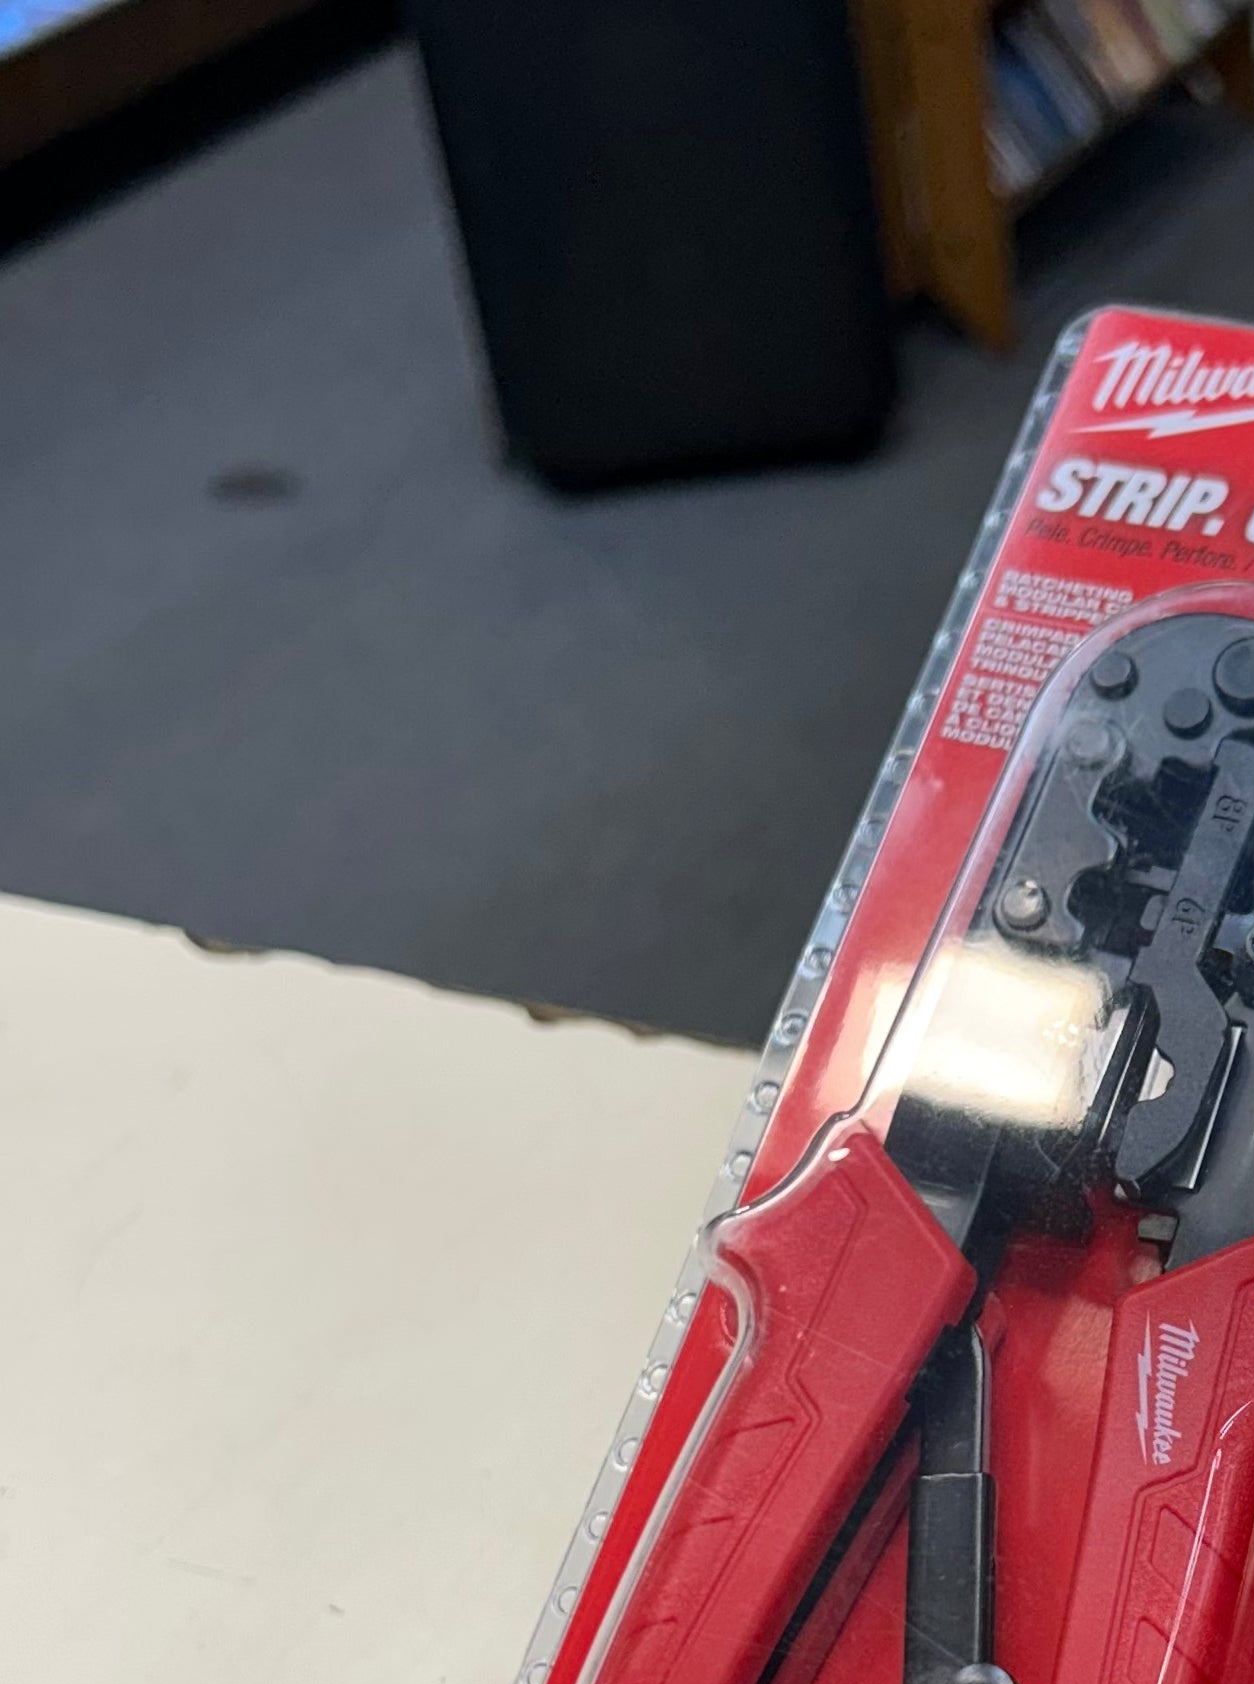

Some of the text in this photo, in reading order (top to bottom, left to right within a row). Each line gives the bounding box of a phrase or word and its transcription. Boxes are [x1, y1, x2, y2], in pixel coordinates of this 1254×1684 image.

[1035, 457, 1230, 538] STRIP.
[1077, 528, 1154, 559] Crimpe.
[1159, 540, 1238, 570] Perfore.
[998, 582, 1101, 611] MODULAR
[1003, 569, 1134, 604] RATCHETING
[1013, 599, 1105, 627] STRIPPE
[984, 617, 1085, 645] CRIMPAD
[1152, 1318, 1201, 1466] Milwaukee
